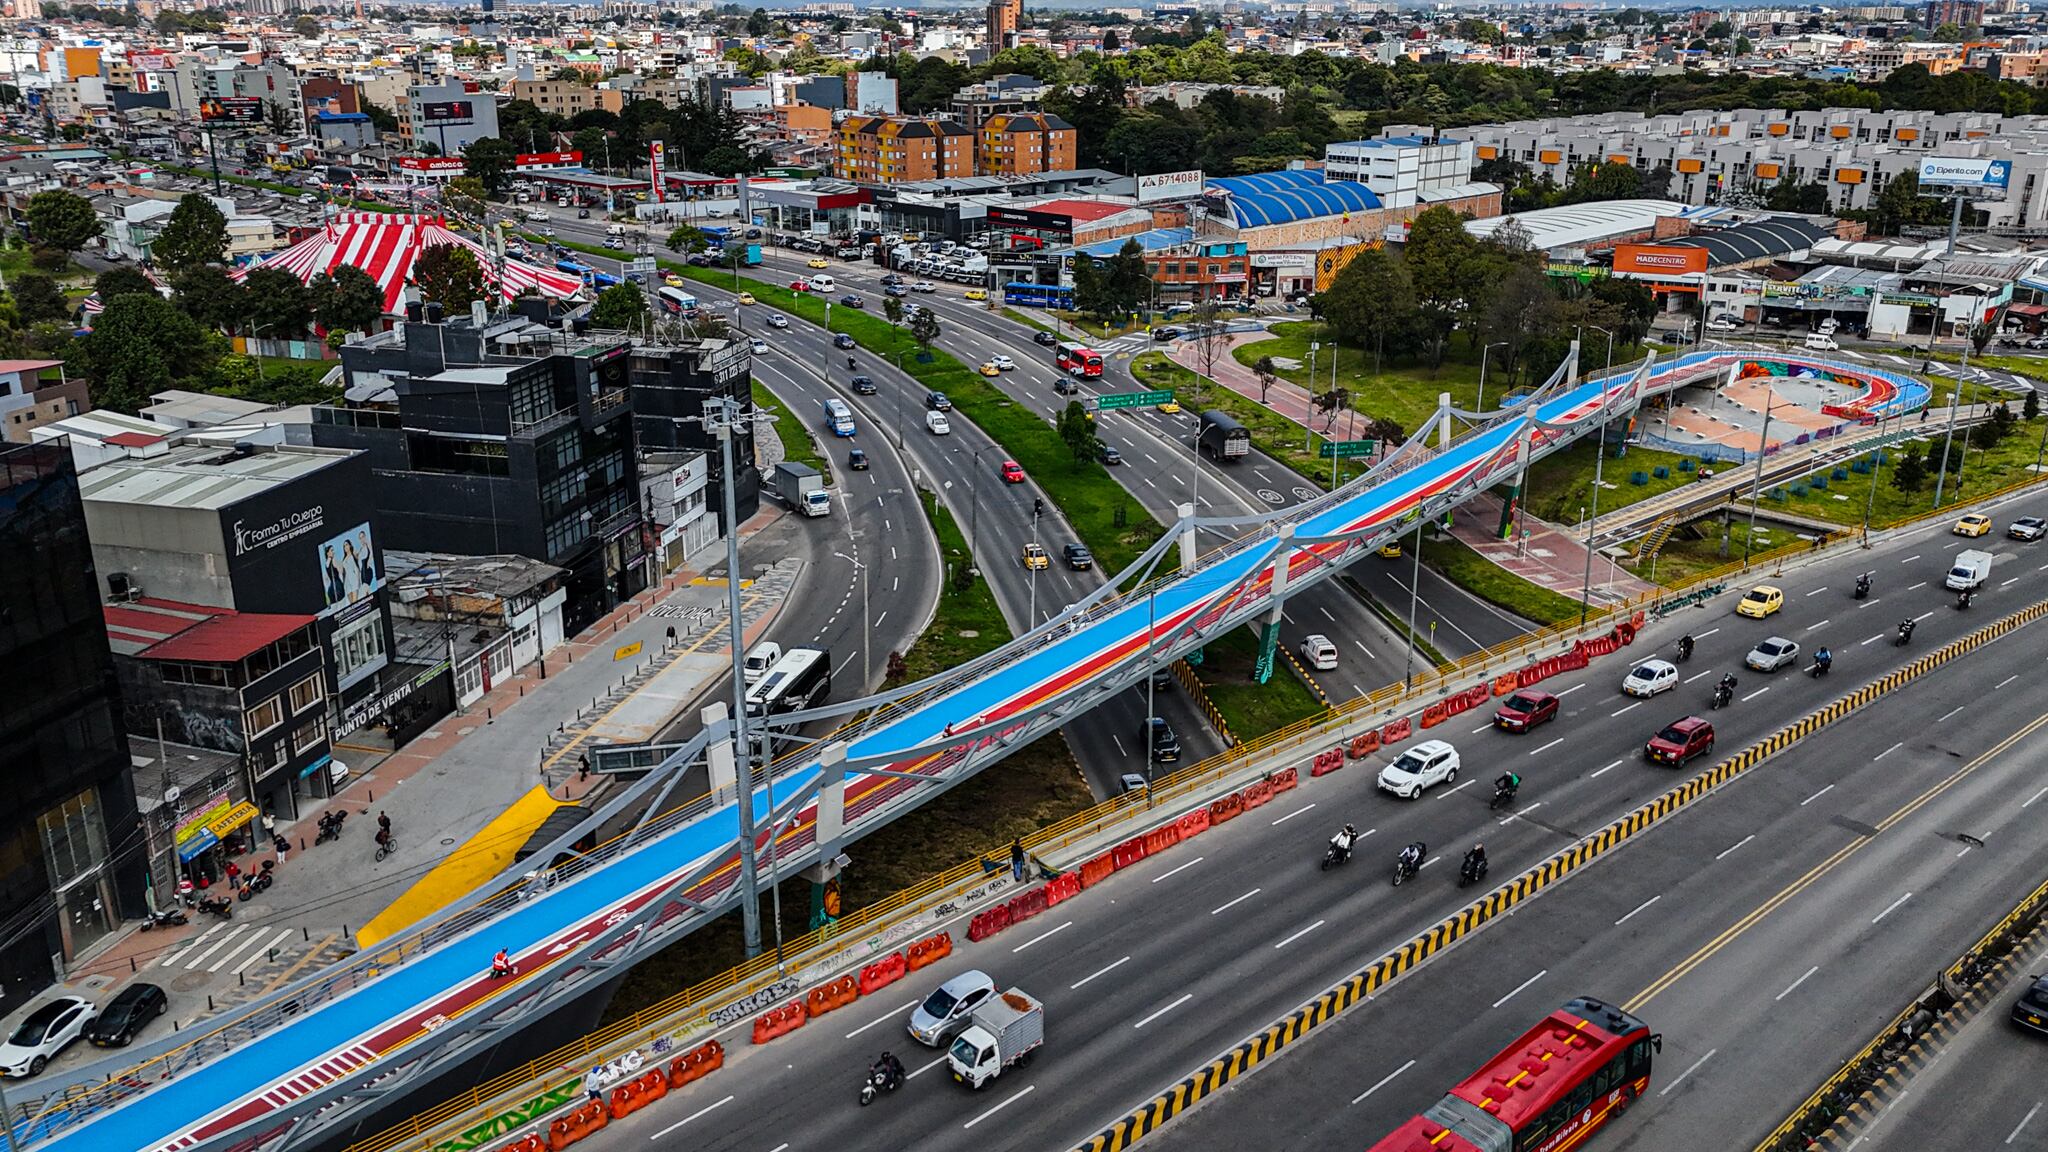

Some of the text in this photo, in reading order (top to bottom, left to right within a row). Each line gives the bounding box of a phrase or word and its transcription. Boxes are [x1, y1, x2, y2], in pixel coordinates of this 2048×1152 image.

[1158, 172, 1199, 186] 6714088
[1936, 166, 1983, 176] Elperito.com
[1549, 263, 1583, 272] MADERAS
[1635, 254, 1687, 265] MADECENTRO
[252, 505, 323, 543] Forma Tu Cuerpo
[266, 519, 324, 549] CENTRO EMPRESARIAL
[334, 683, 412, 742] PUNTO DE VENTA
[211, 804, 254, 833] CAFETERIA
